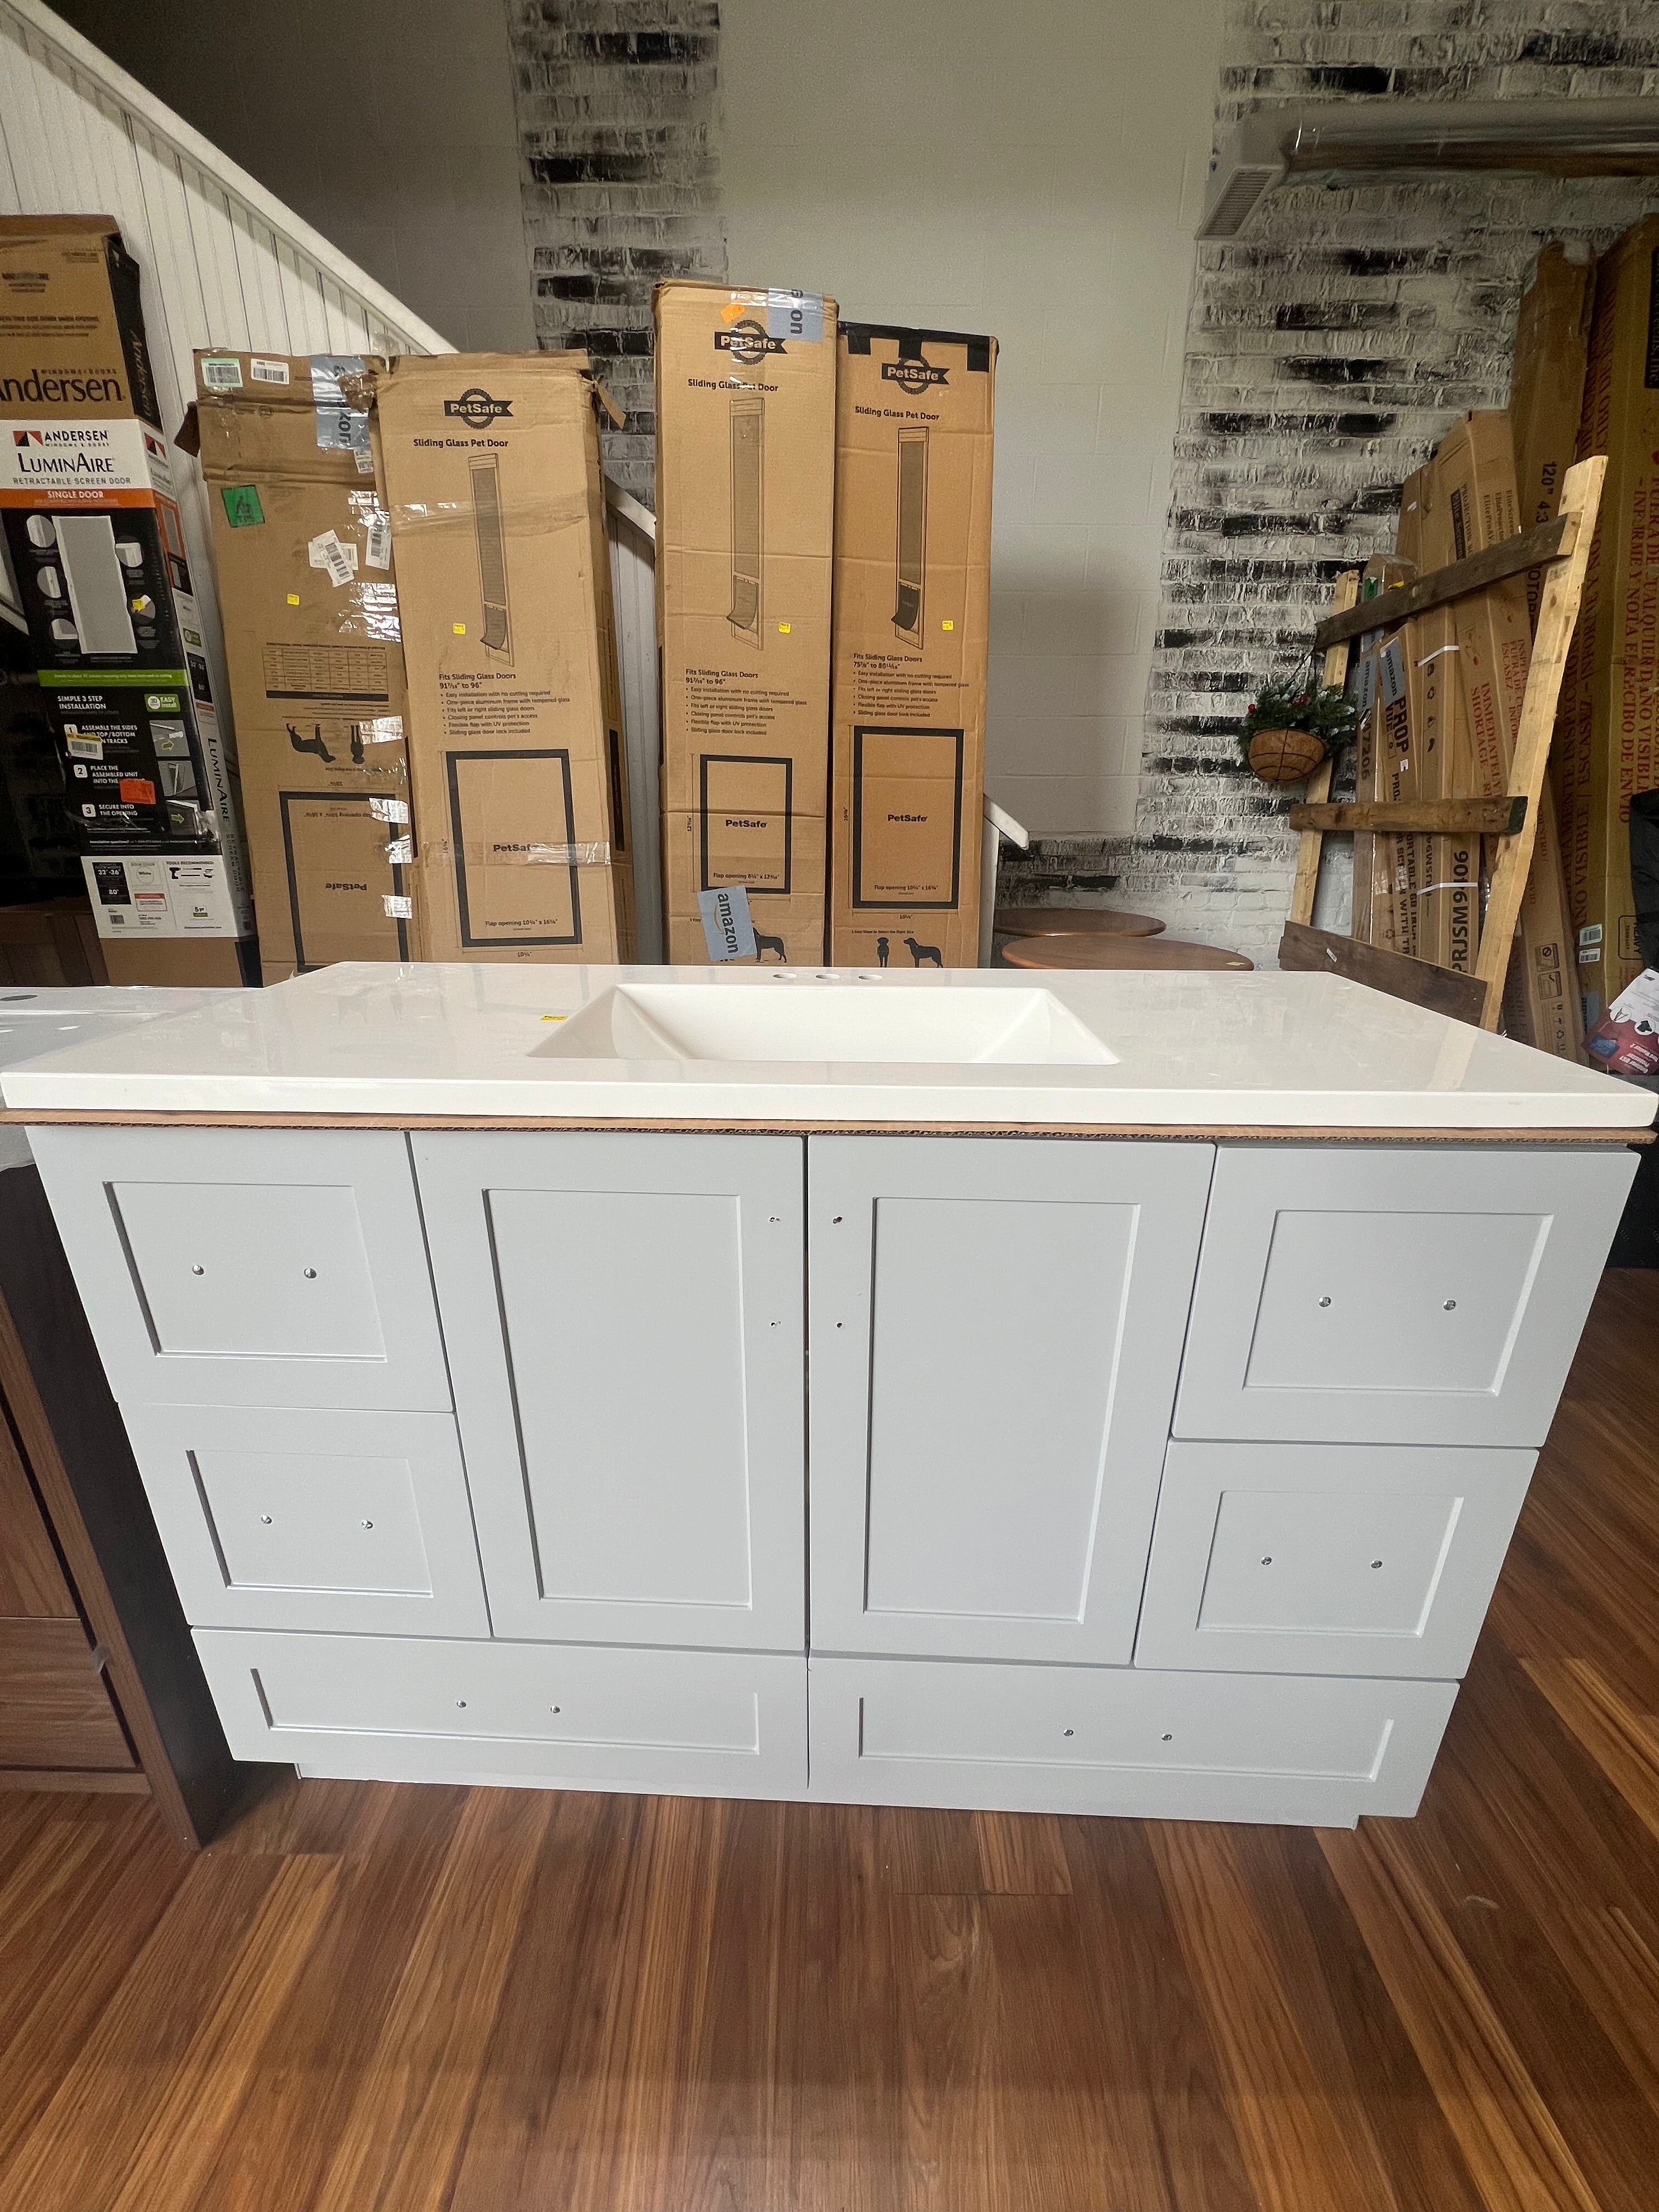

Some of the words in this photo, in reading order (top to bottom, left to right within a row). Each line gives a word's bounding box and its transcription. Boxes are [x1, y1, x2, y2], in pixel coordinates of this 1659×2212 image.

[887, 366, 939, 381] PetSafe
[688, 379, 716, 390] Sliding
[719, 381, 740, 390] Glass
[758, 383, 779, 392] Door
[450, 403, 503, 414] PetSafe
[855, 406, 882, 417] Sliding
[883, 409, 904, 418] Glass
[906, 411, 919, 419] Pet
[44, 430, 109, 442] ANDERSEN
[413, 439, 444, 449] Sliding
[445, 439, 469, 448] Glass
[471, 439, 486, 448] Pet
[487, 439, 509, 448] Door
[48, 490, 77, 499] SINGLE
[79, 490, 104, 499] DOOR
[1536, 500, 1551, 523] 4:3
[1625, 588, 1640, 637] NOTA
[1641, 573, 1658, 665] UALQUIER
[865, 653, 885, 662] Sliding
[698, 669, 719, 678] Sliding
[1386, 651, 1398, 697] amazon
[1362, 661, 1372, 708] amazon
[1393, 695, 1409, 753] PROP
[1471, 687, 1489, 768] SHORTAGE
[1481, 682, 1502, 791] IMMEDIATELY
[1620, 738, 1634, 761] DE
[725, 819, 768, 828] PetSafe
[325, 883, 368, 891] PetSafe
[717, 893, 739, 954] amazon
